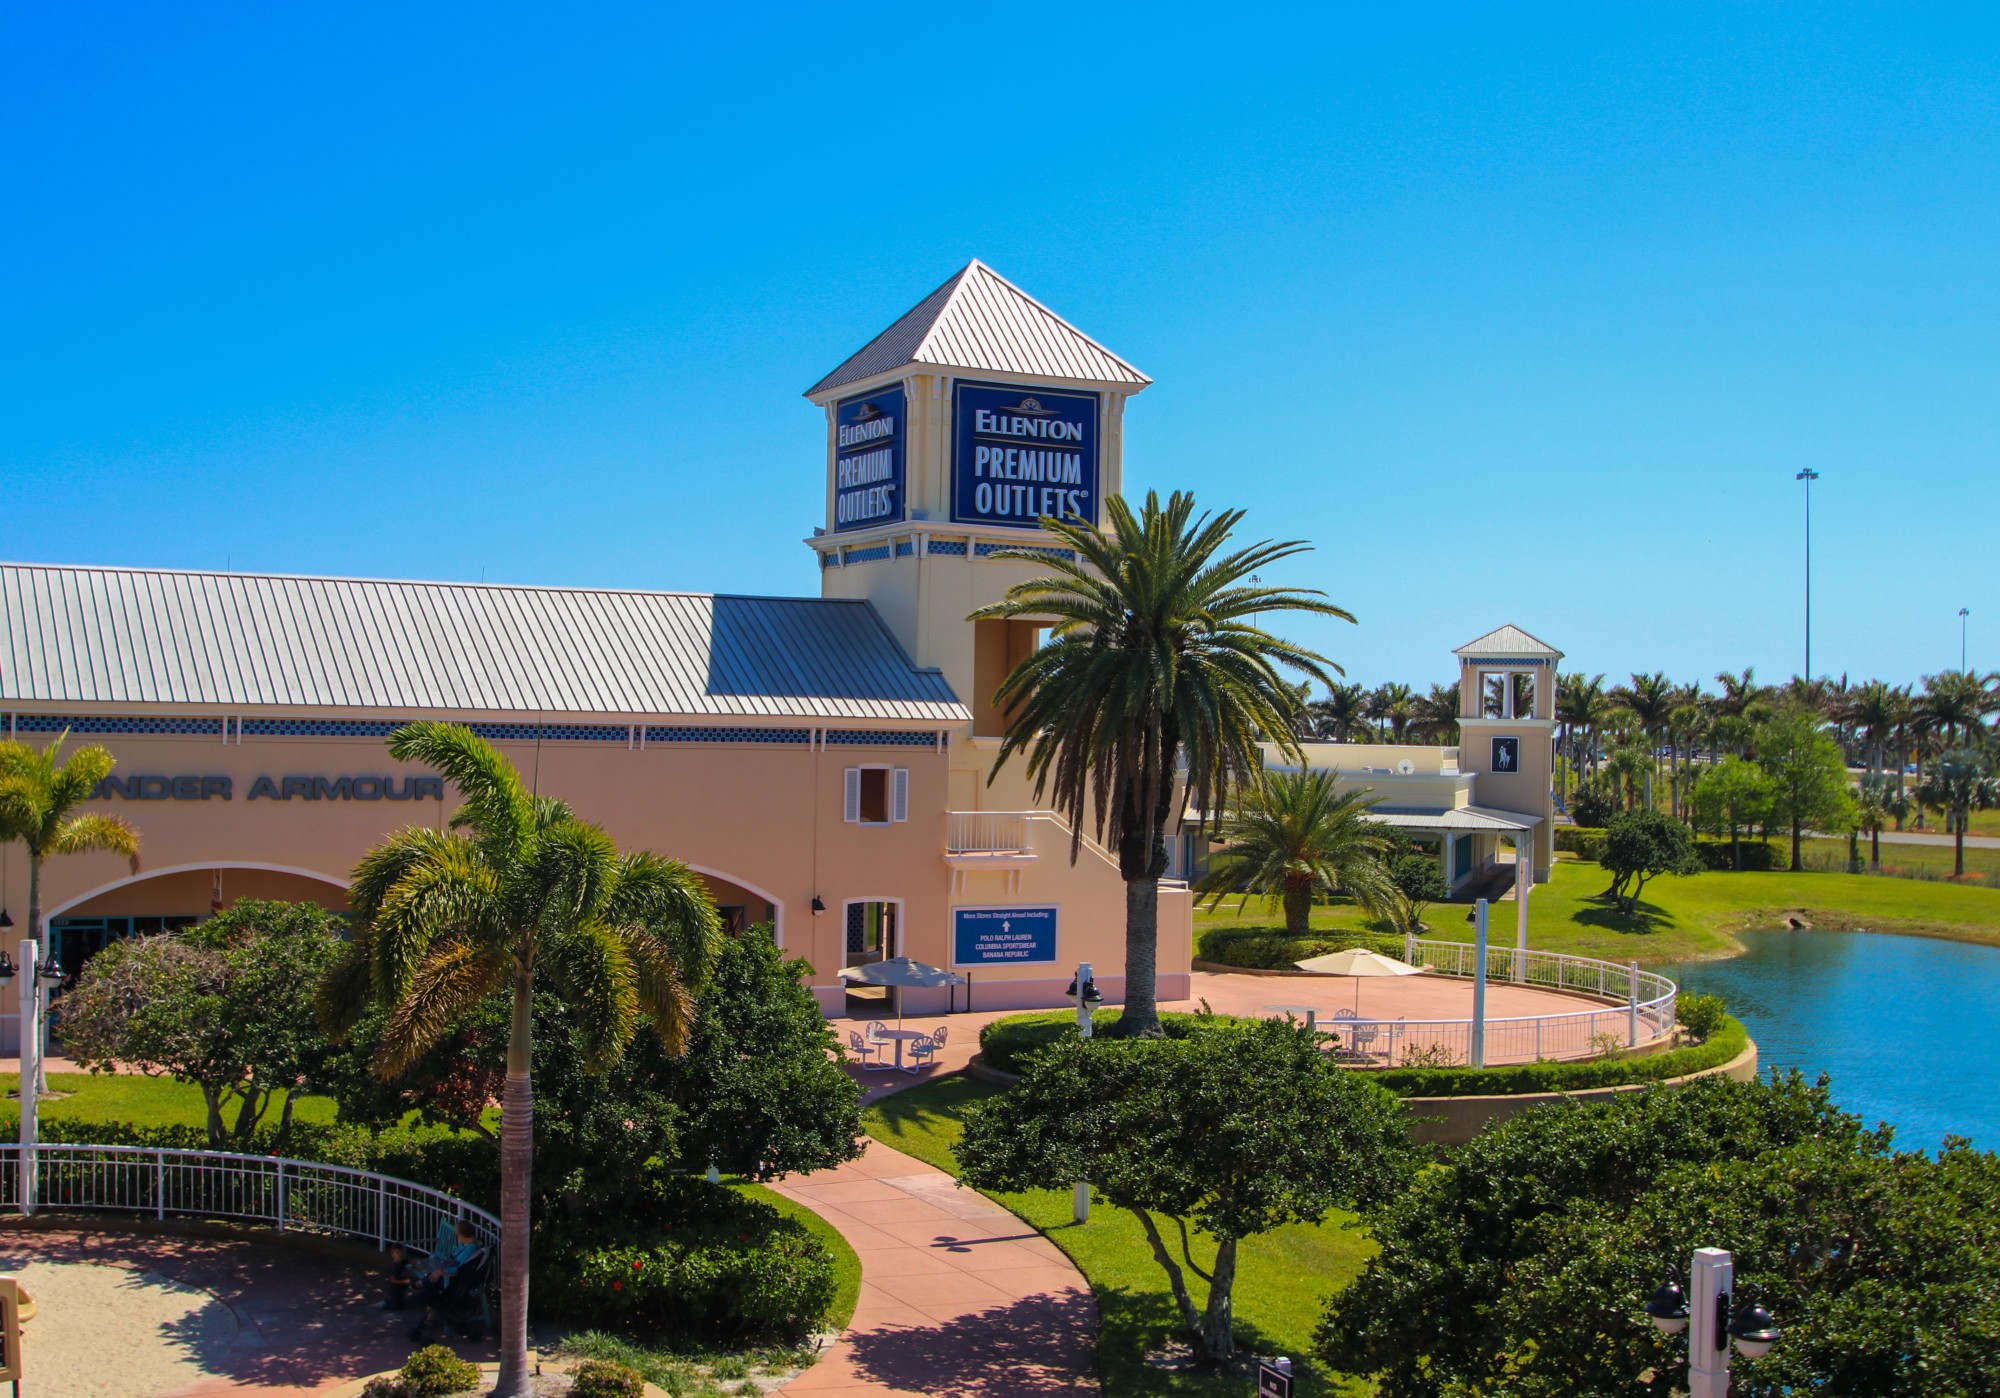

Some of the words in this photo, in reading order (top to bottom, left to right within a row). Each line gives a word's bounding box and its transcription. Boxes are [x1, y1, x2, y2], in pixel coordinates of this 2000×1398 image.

[975, 409, 1083, 441] ELLENTON
[838, 448, 893, 489] PREMIUM
[974, 446, 1082, 485] PREMIUM
[247, 776, 445, 801] ARMOUR
[992, 912, 1011, 920] Straight
[975, 943, 1002, 951] COLUMBIA
[1002, 942, 1037, 950] SPORTSWEAR
[1004, 950, 1030, 958] REPUBLIC
